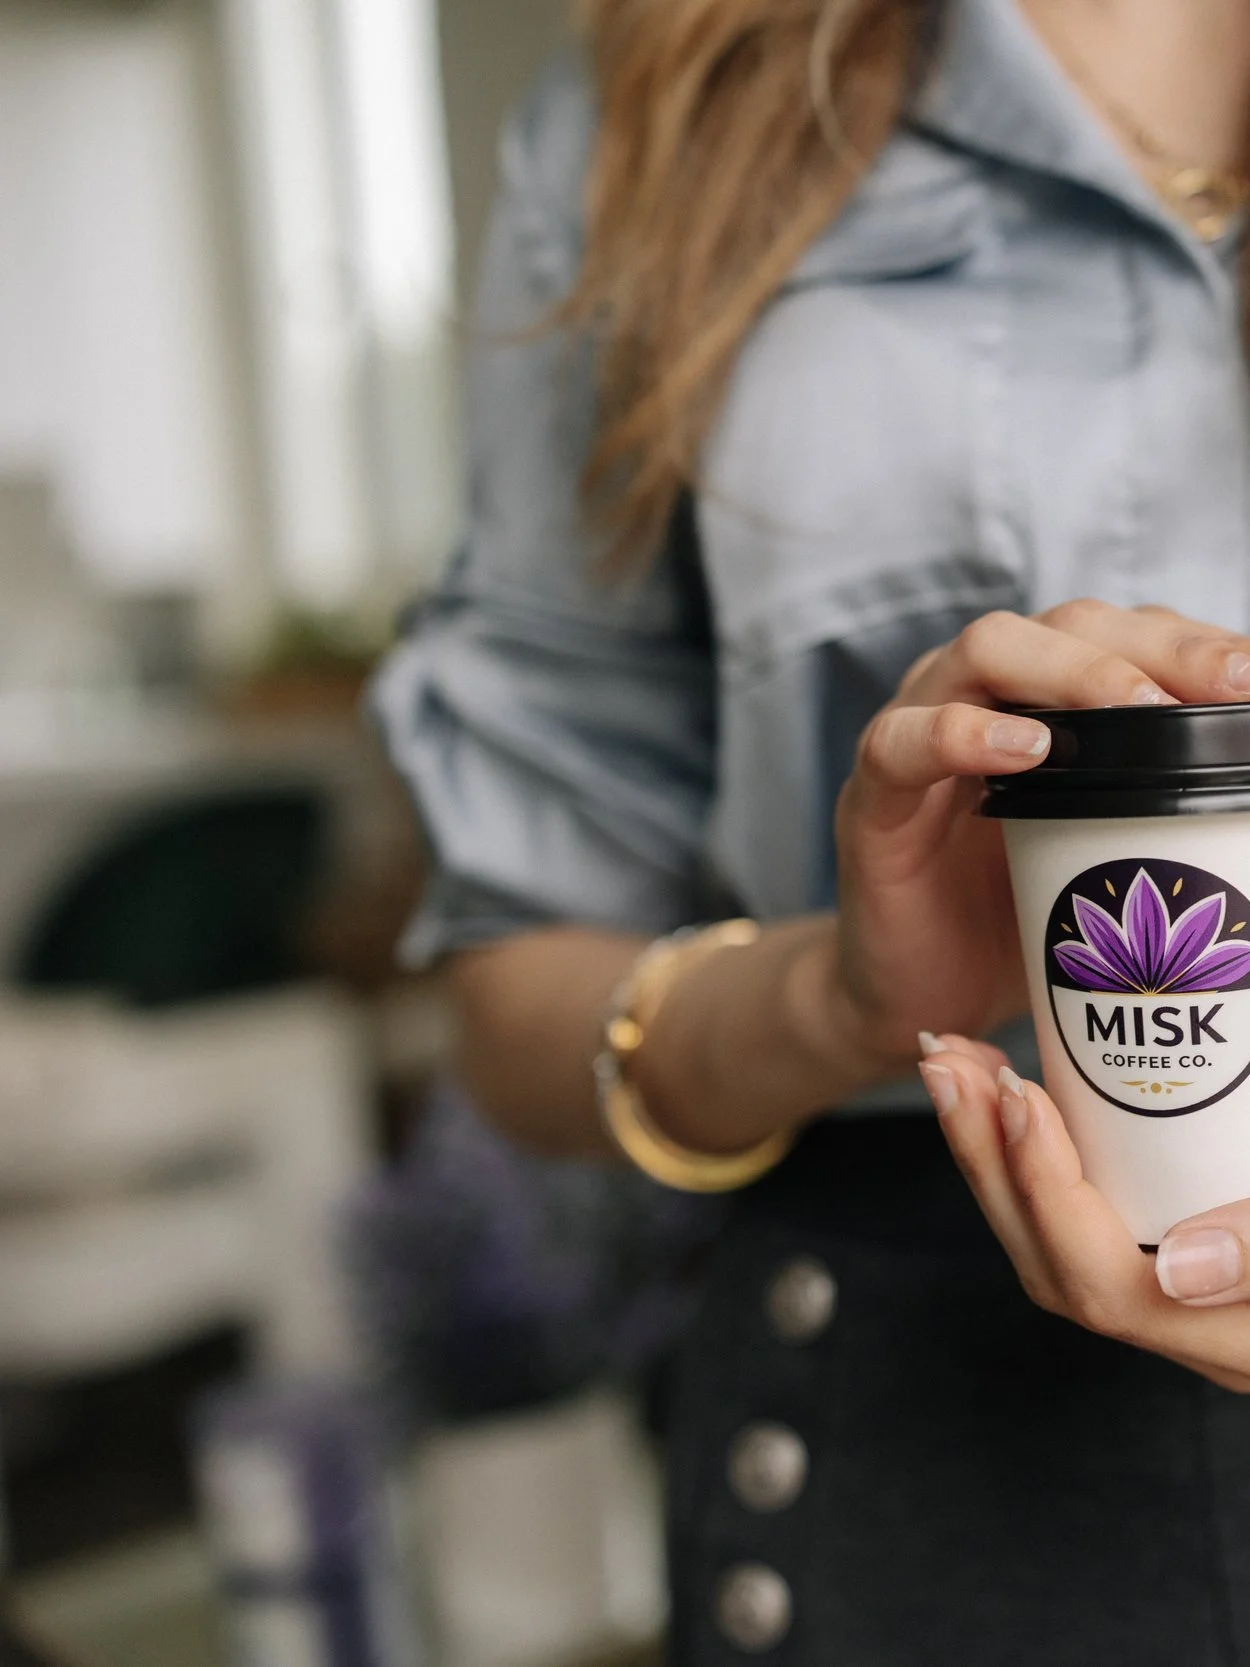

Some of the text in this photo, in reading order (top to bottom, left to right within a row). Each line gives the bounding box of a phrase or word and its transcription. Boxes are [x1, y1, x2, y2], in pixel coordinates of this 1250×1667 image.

[1085, 1002, 1228, 1047] MISK
[1102, 1053, 1213, 1069] COFFEE CO.
